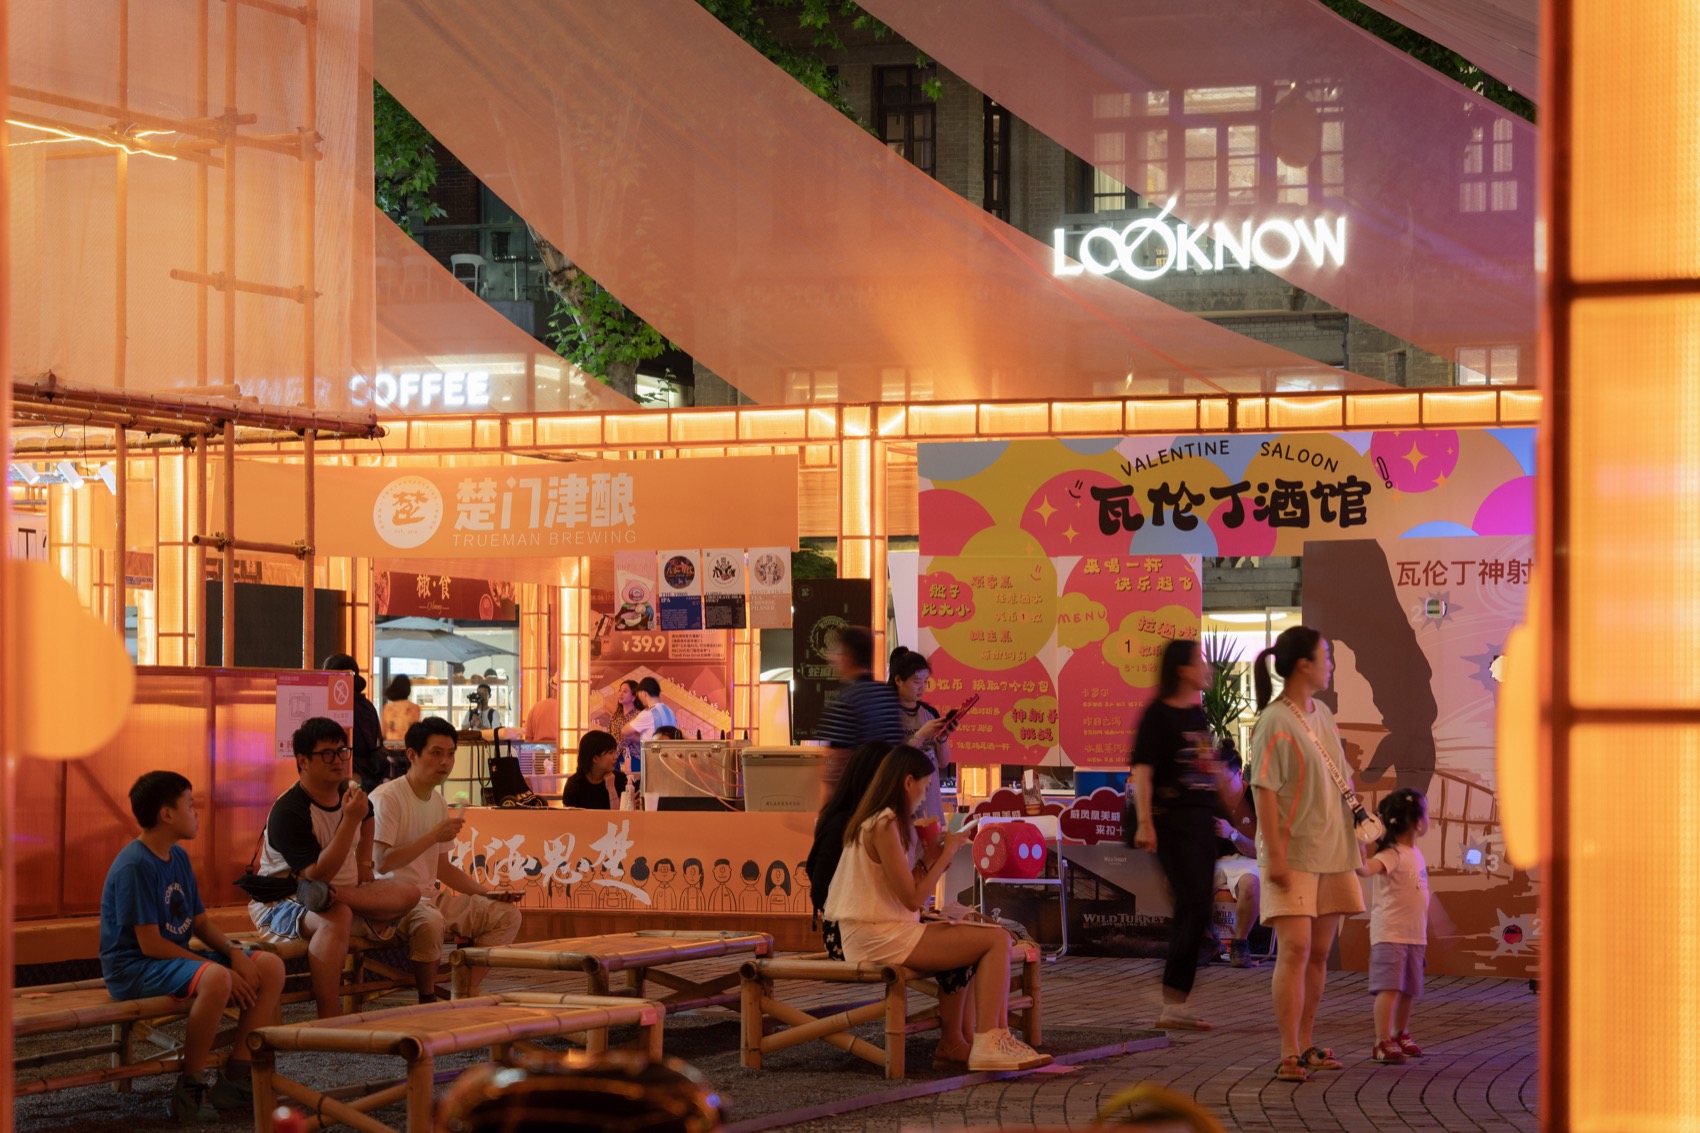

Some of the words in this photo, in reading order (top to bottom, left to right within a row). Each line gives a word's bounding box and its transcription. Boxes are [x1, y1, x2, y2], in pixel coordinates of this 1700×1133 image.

[350, 372, 489, 407] COFFEE
[1120, 440, 1230, 477] VALENTINE
[1260, 441, 1339, 473] SALOON
[453, 472, 636, 532] 楚门津酿
[1090, 475, 1371, 535] 瓦伦丁酒馆
[452, 533, 541, 547] TRUEMAN
[549, 530, 636, 546] BREWING
[1083, 557, 1163, 574] 来喝一杯
[1114, 575, 1193, 592] 快乐起飞
[922, 603, 971, 617] 比大小
[1058, 610, 1106, 624] MENU
[1411, 605, 1422, 622] 2
[622, 635, 666, 652] ¥39.9
[1012, 709, 1058, 724] 神射手
[1020, 727, 1054, 741] 挑战
[1487, 854, 1499, 871] 3
[1083, 913, 1118, 923] WILD
[1118, 913, 1166, 924] TURKEY
